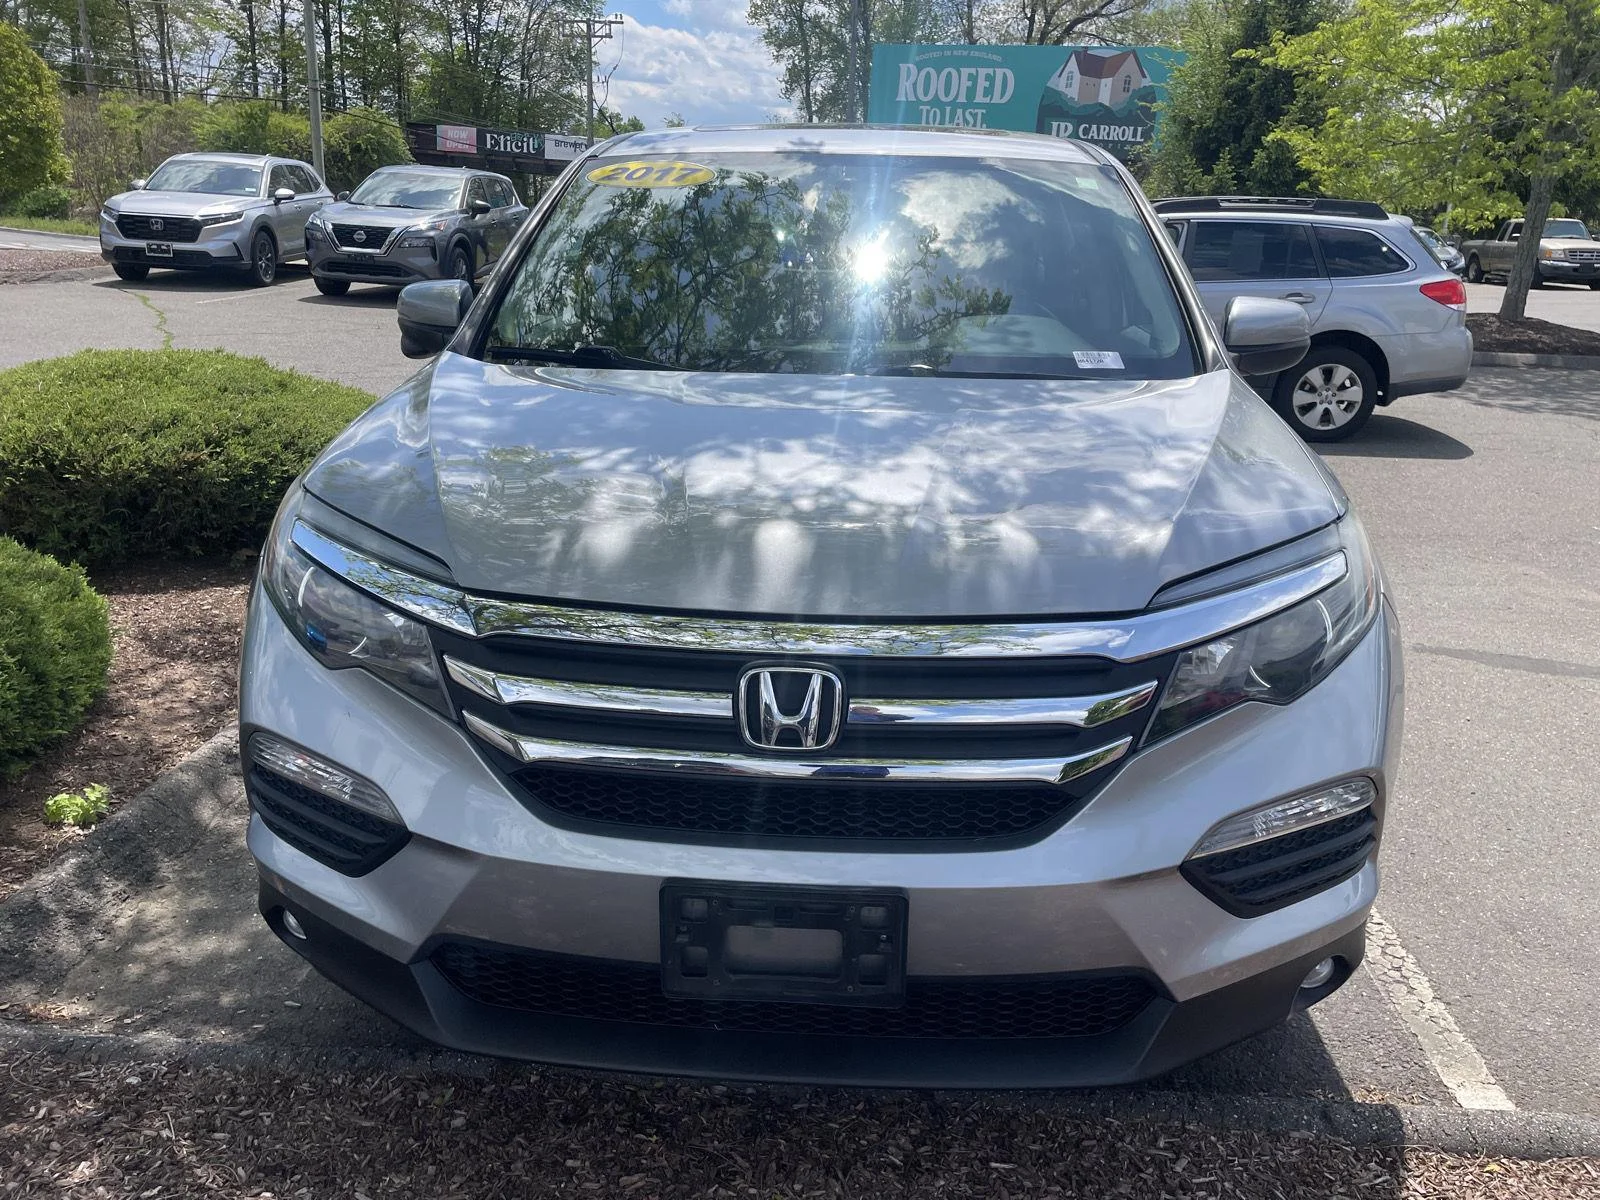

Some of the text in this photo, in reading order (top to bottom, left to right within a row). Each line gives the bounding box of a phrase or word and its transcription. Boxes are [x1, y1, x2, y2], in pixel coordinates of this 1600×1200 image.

[896, 63, 1015, 104] ROOFED
[919, 106, 941, 126] TO
[447, 129, 469, 139] NOW
[1078, 123, 1145, 142] CARROLL
[446, 139, 469, 150] OPEN
[595, 166, 703, 182] 2017
